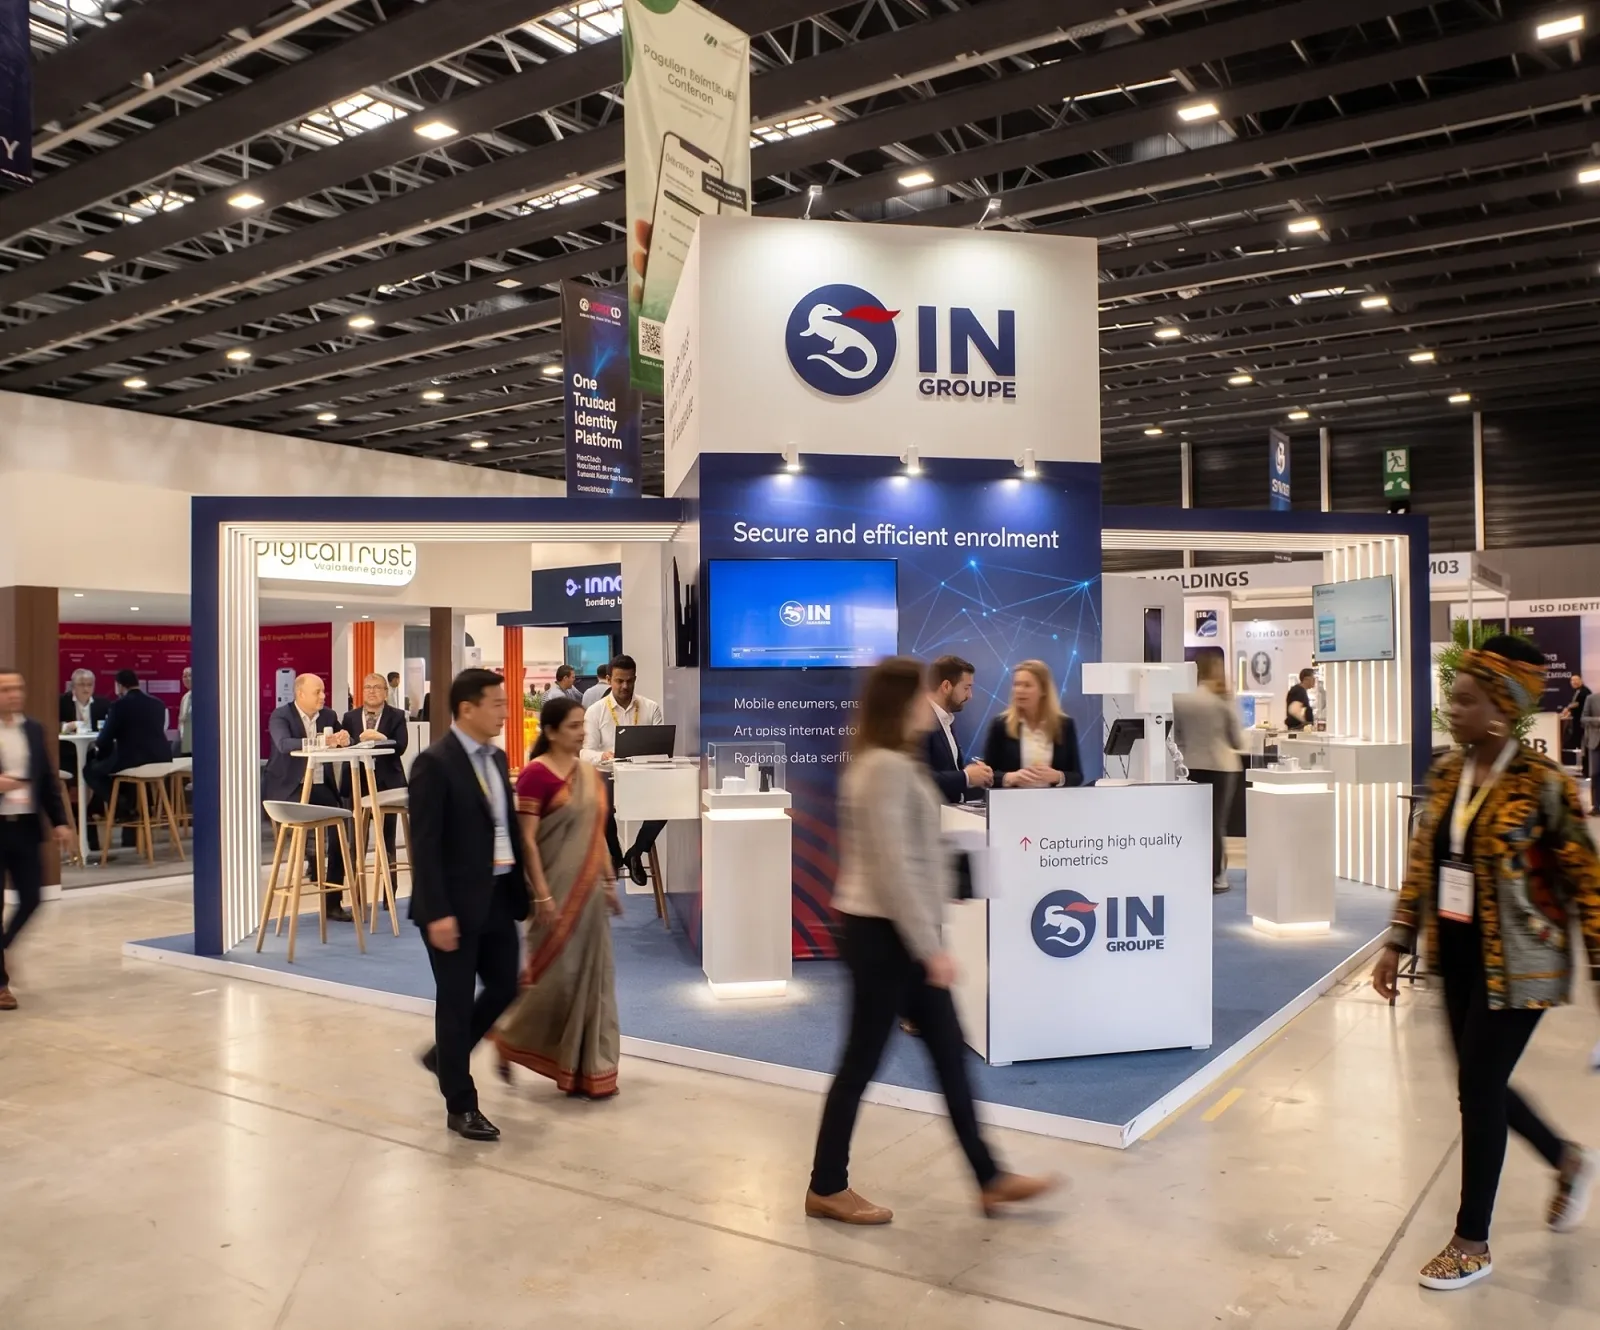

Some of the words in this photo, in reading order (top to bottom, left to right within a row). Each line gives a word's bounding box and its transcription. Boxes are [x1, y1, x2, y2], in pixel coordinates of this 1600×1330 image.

[918, 305, 1015, 377] IN
[573, 373, 598, 391] One
[919, 378, 1017, 398] GROUPE
[574, 410, 618, 434] Identity
[575, 429, 623, 450] Platform
[733, 521, 809, 543] Secure
[815, 522, 856, 544] and
[863, 523, 948, 546] efficient
[954, 526, 1060, 548] enrolment
[1153, 571, 1250, 589] LDINGS
[807, 604, 831, 621] IN
[1529, 604, 1555, 614] USD
[734, 697, 775, 710] Mobile
[790, 751, 818, 764] data
[1039, 836, 1104, 852] Capturing
[1107, 834, 1136, 850] high
[1139, 832, 1183, 849] quality
[1039, 854, 1109, 868] biometrics
[1106, 895, 1165, 939] IN
[1106, 938, 1165, 952] GROUPE
